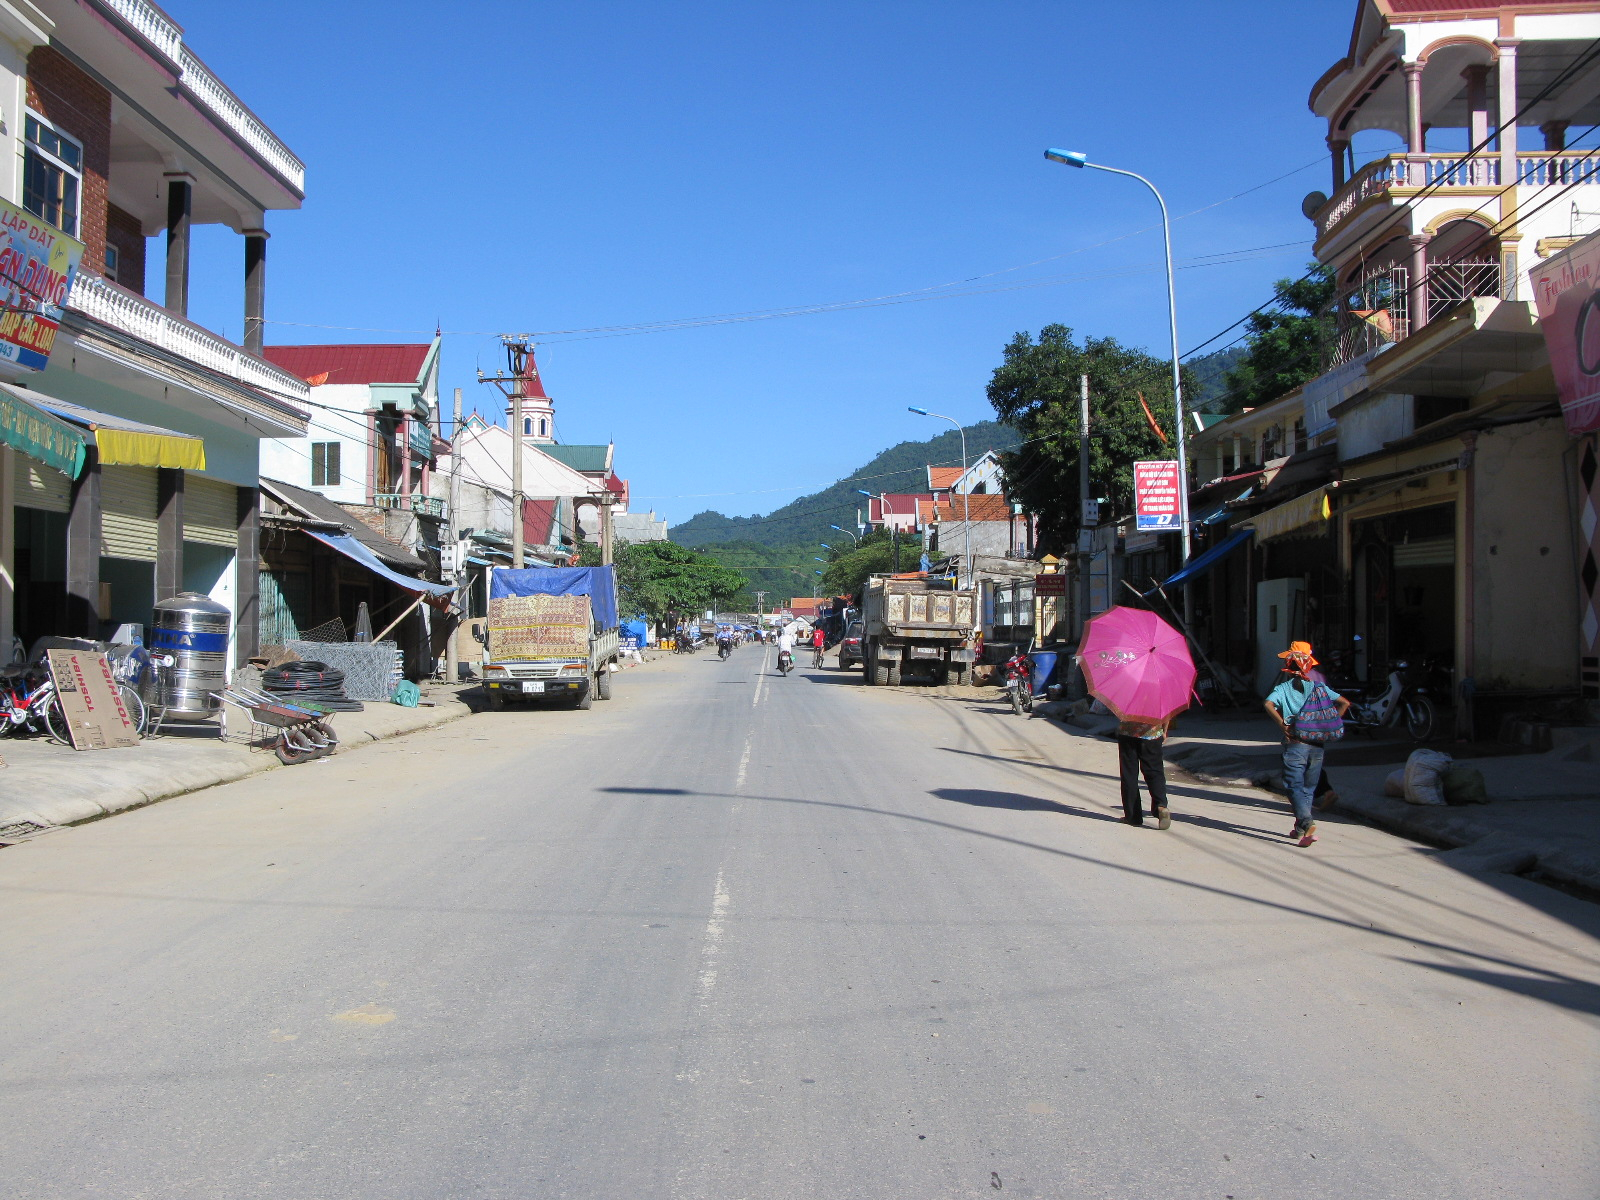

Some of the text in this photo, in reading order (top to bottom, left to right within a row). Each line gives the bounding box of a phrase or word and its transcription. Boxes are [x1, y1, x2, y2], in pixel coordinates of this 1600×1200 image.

[1539, 263, 1591, 305] Fashion
[71, 656, 95, 713] TOSHIBA
[98, 657, 131, 729] TOSHIBA
